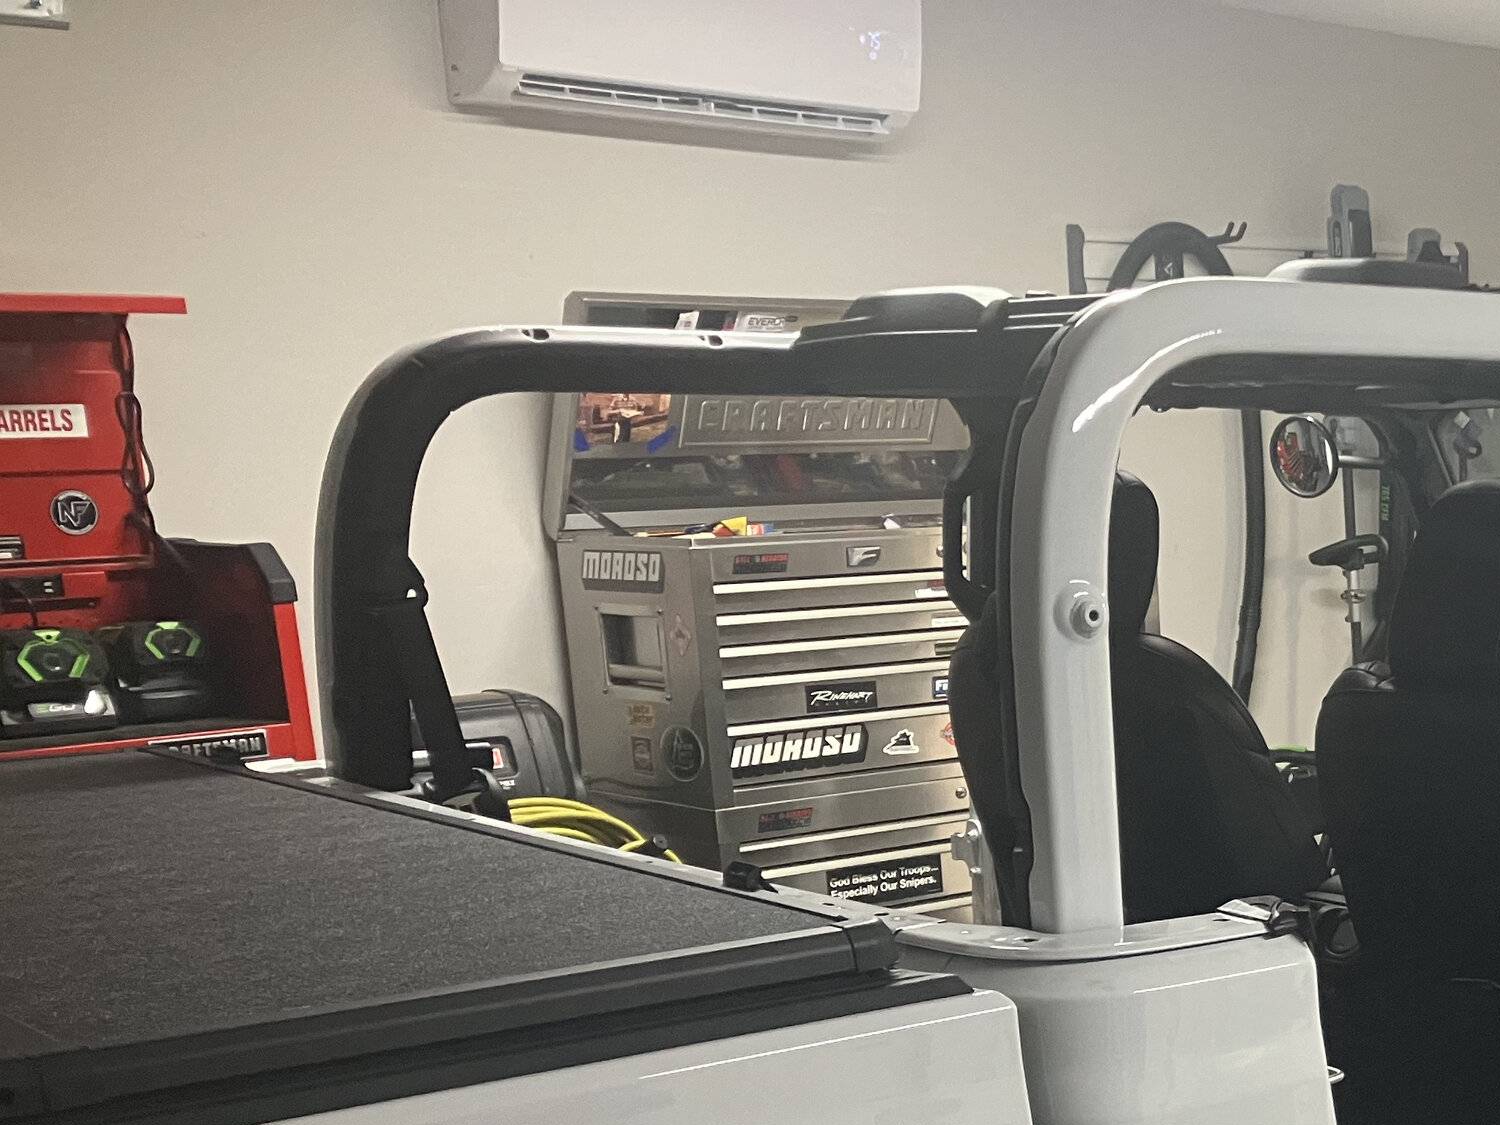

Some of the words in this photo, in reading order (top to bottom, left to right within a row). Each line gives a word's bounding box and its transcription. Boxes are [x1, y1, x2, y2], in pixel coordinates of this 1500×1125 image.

[698, 400, 924, 432] CRAFTSMAN
[582, 551, 662, 583] MOROSO
[730, 724, 862, 769] MOROSO
[829, 877, 850, 888] God
[852, 873, 879, 885] Bless
[880, 869, 897, 880] Our
[830, 883, 879, 899] Especially
[880, 880, 898, 892] Our
[899, 874, 937, 889] Snipers.
